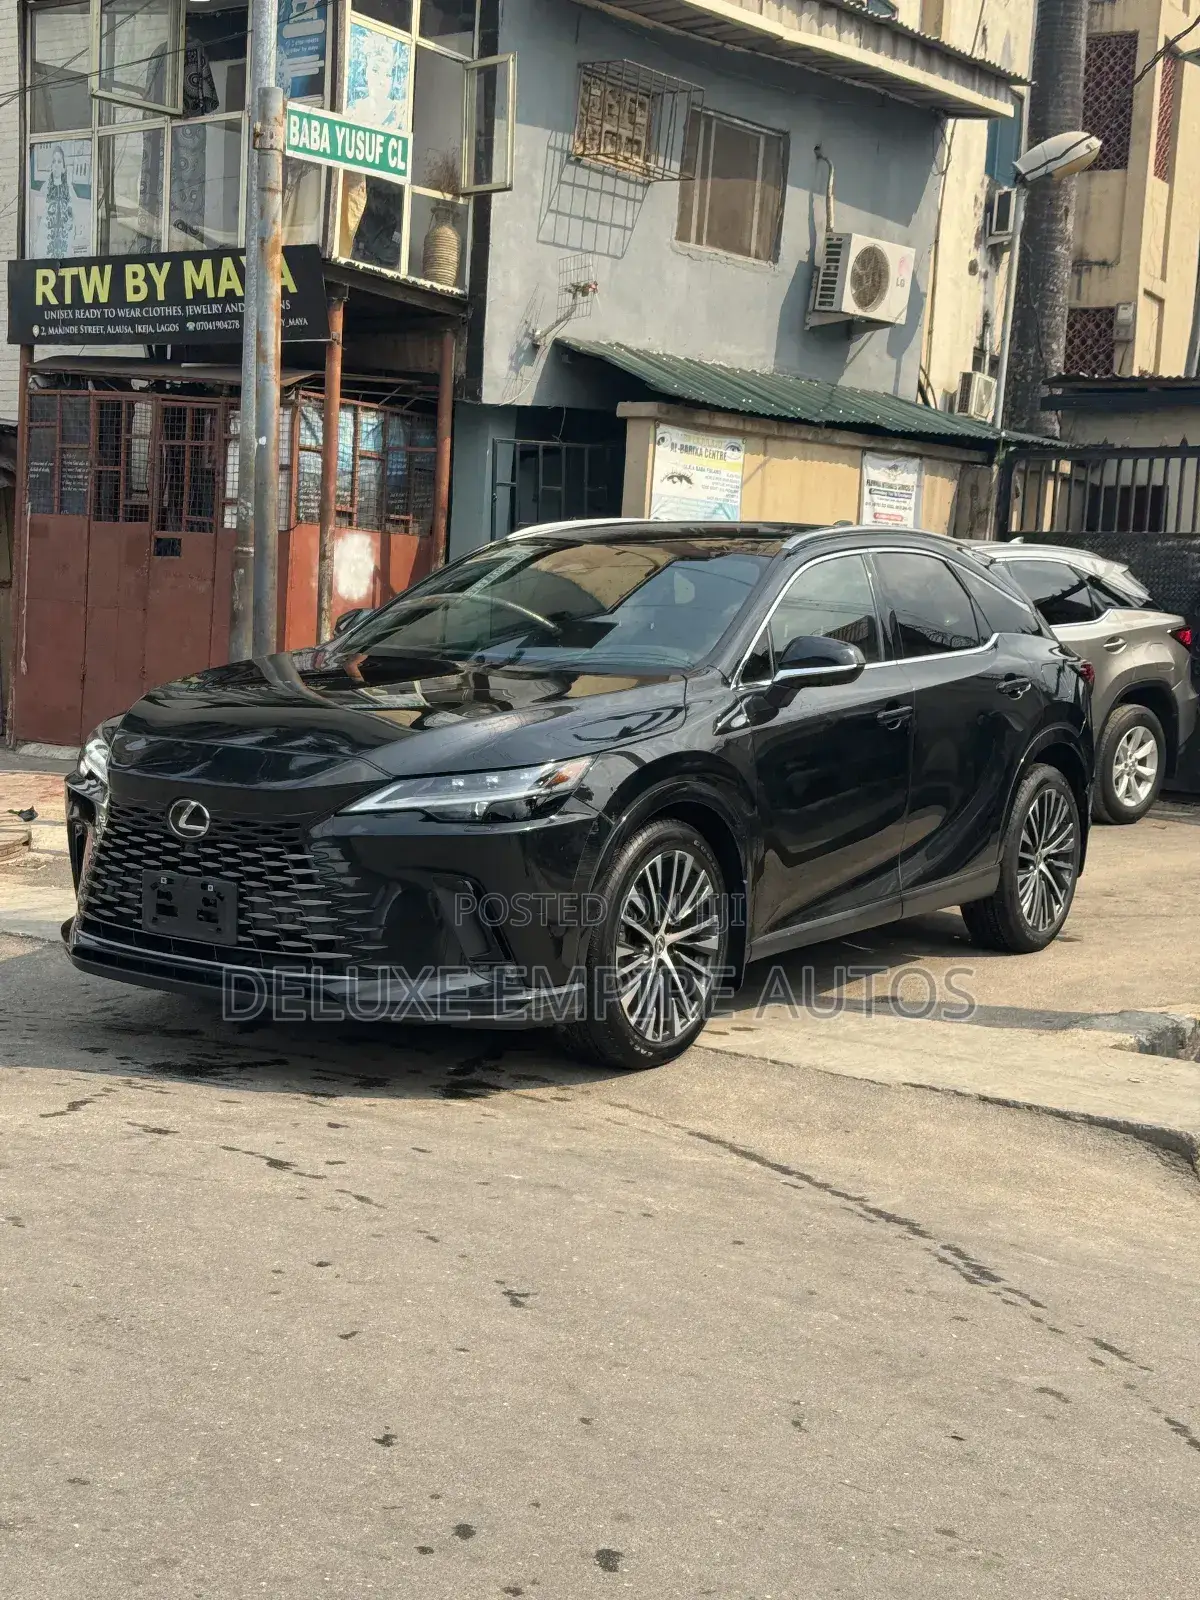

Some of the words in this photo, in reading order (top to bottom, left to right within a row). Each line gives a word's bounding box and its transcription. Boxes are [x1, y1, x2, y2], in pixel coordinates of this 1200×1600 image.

[289, 114, 331, 154] BABA
[335, 125, 385, 165] YUSUF
[387, 138, 406, 170] CL
[35, 264, 113, 306] RTW
[125, 261, 172, 303] BY
[183, 253, 298, 300] MAA
[44, 309, 73, 320] UNISEX
[75, 308, 101, 319] READY
[102, 308, 116, 318] TO
[117, 307, 142, 318] WEAR
[142, 305, 184, 317] CLOTHES,
[185, 303, 224, 317] JEWELRY
[225, 302, 246, 314] AND
[48, 324, 79, 335] MAKINDE
[156, 322, 180, 333] LAGOS
[195, 319, 240, 331] 07041904278
